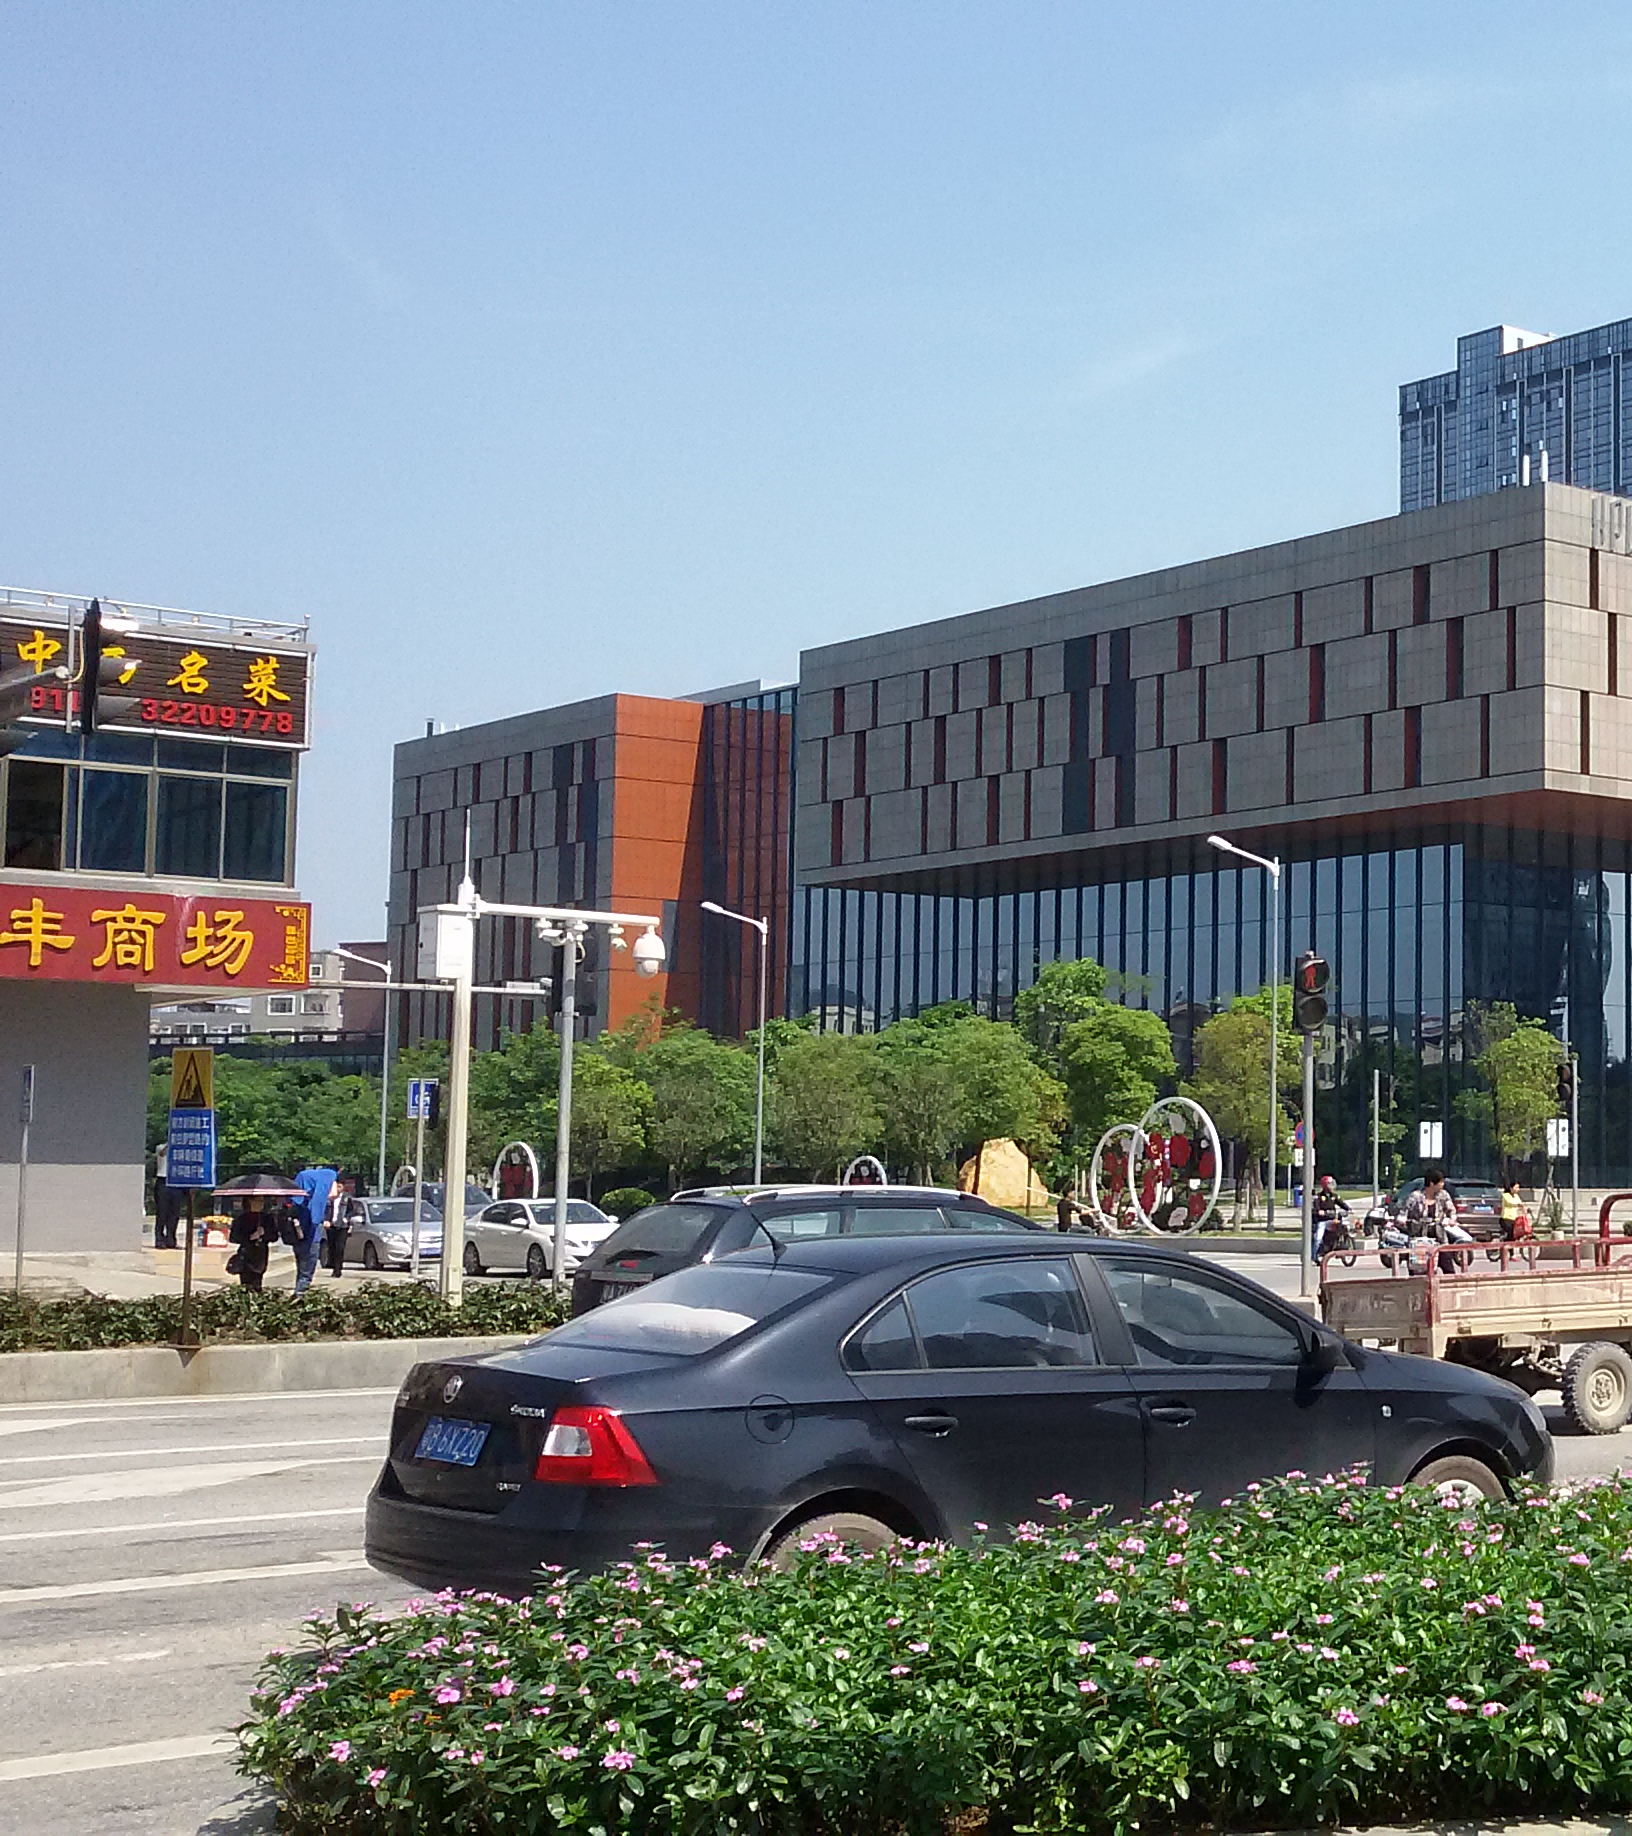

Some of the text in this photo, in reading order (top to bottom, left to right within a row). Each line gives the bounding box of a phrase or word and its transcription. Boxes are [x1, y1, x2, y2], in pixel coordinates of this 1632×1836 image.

[140, 697, 294, 735] 32209778
[0, 897, 254, 976] 丰商场
